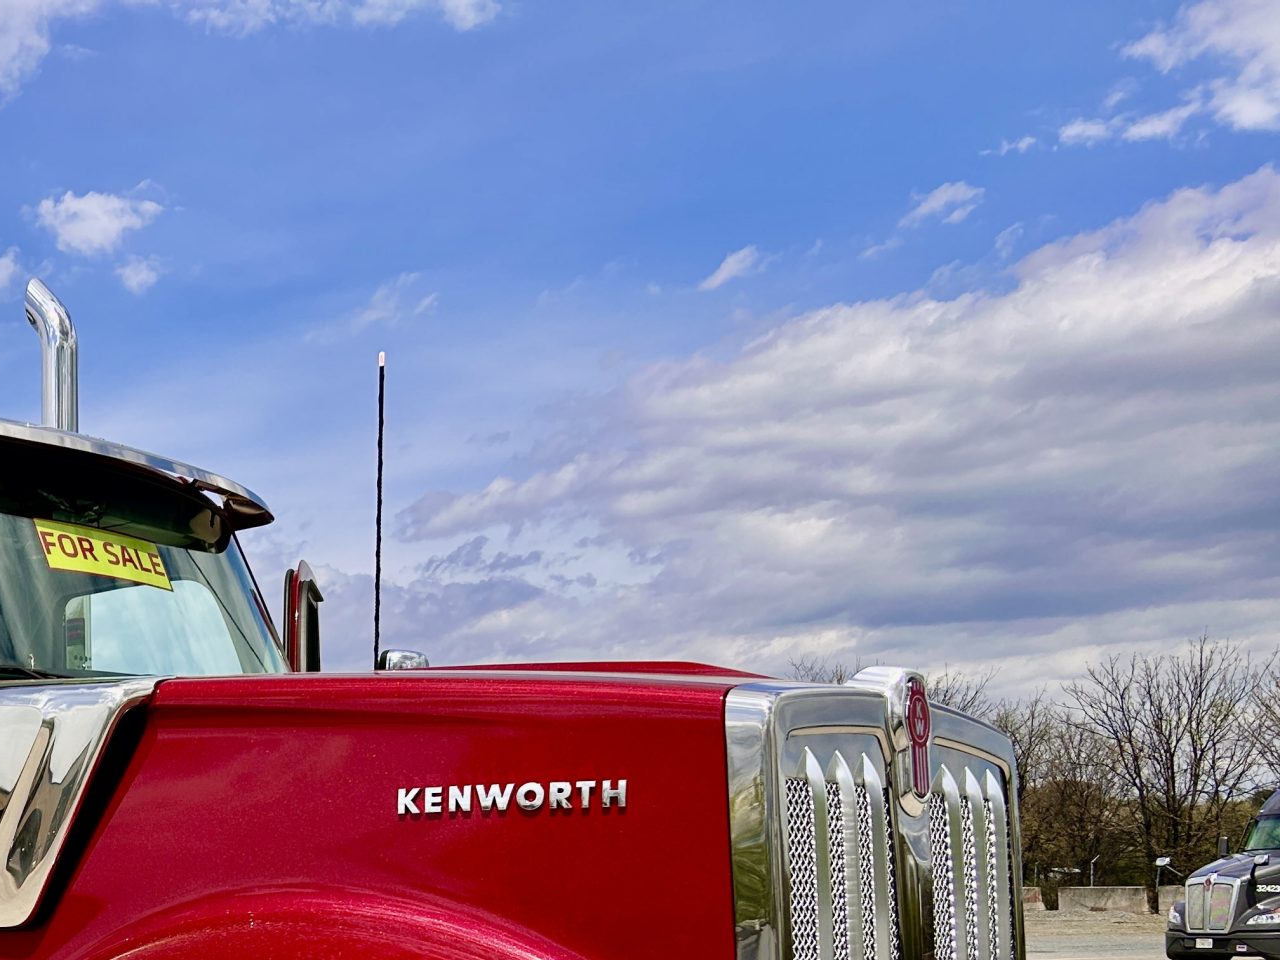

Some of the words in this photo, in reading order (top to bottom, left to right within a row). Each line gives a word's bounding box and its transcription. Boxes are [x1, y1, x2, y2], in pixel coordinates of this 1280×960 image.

[39, 531, 99, 562] FOR
[102, 542, 166, 577] SALE
[397, 779, 627, 815] KENWORTH
